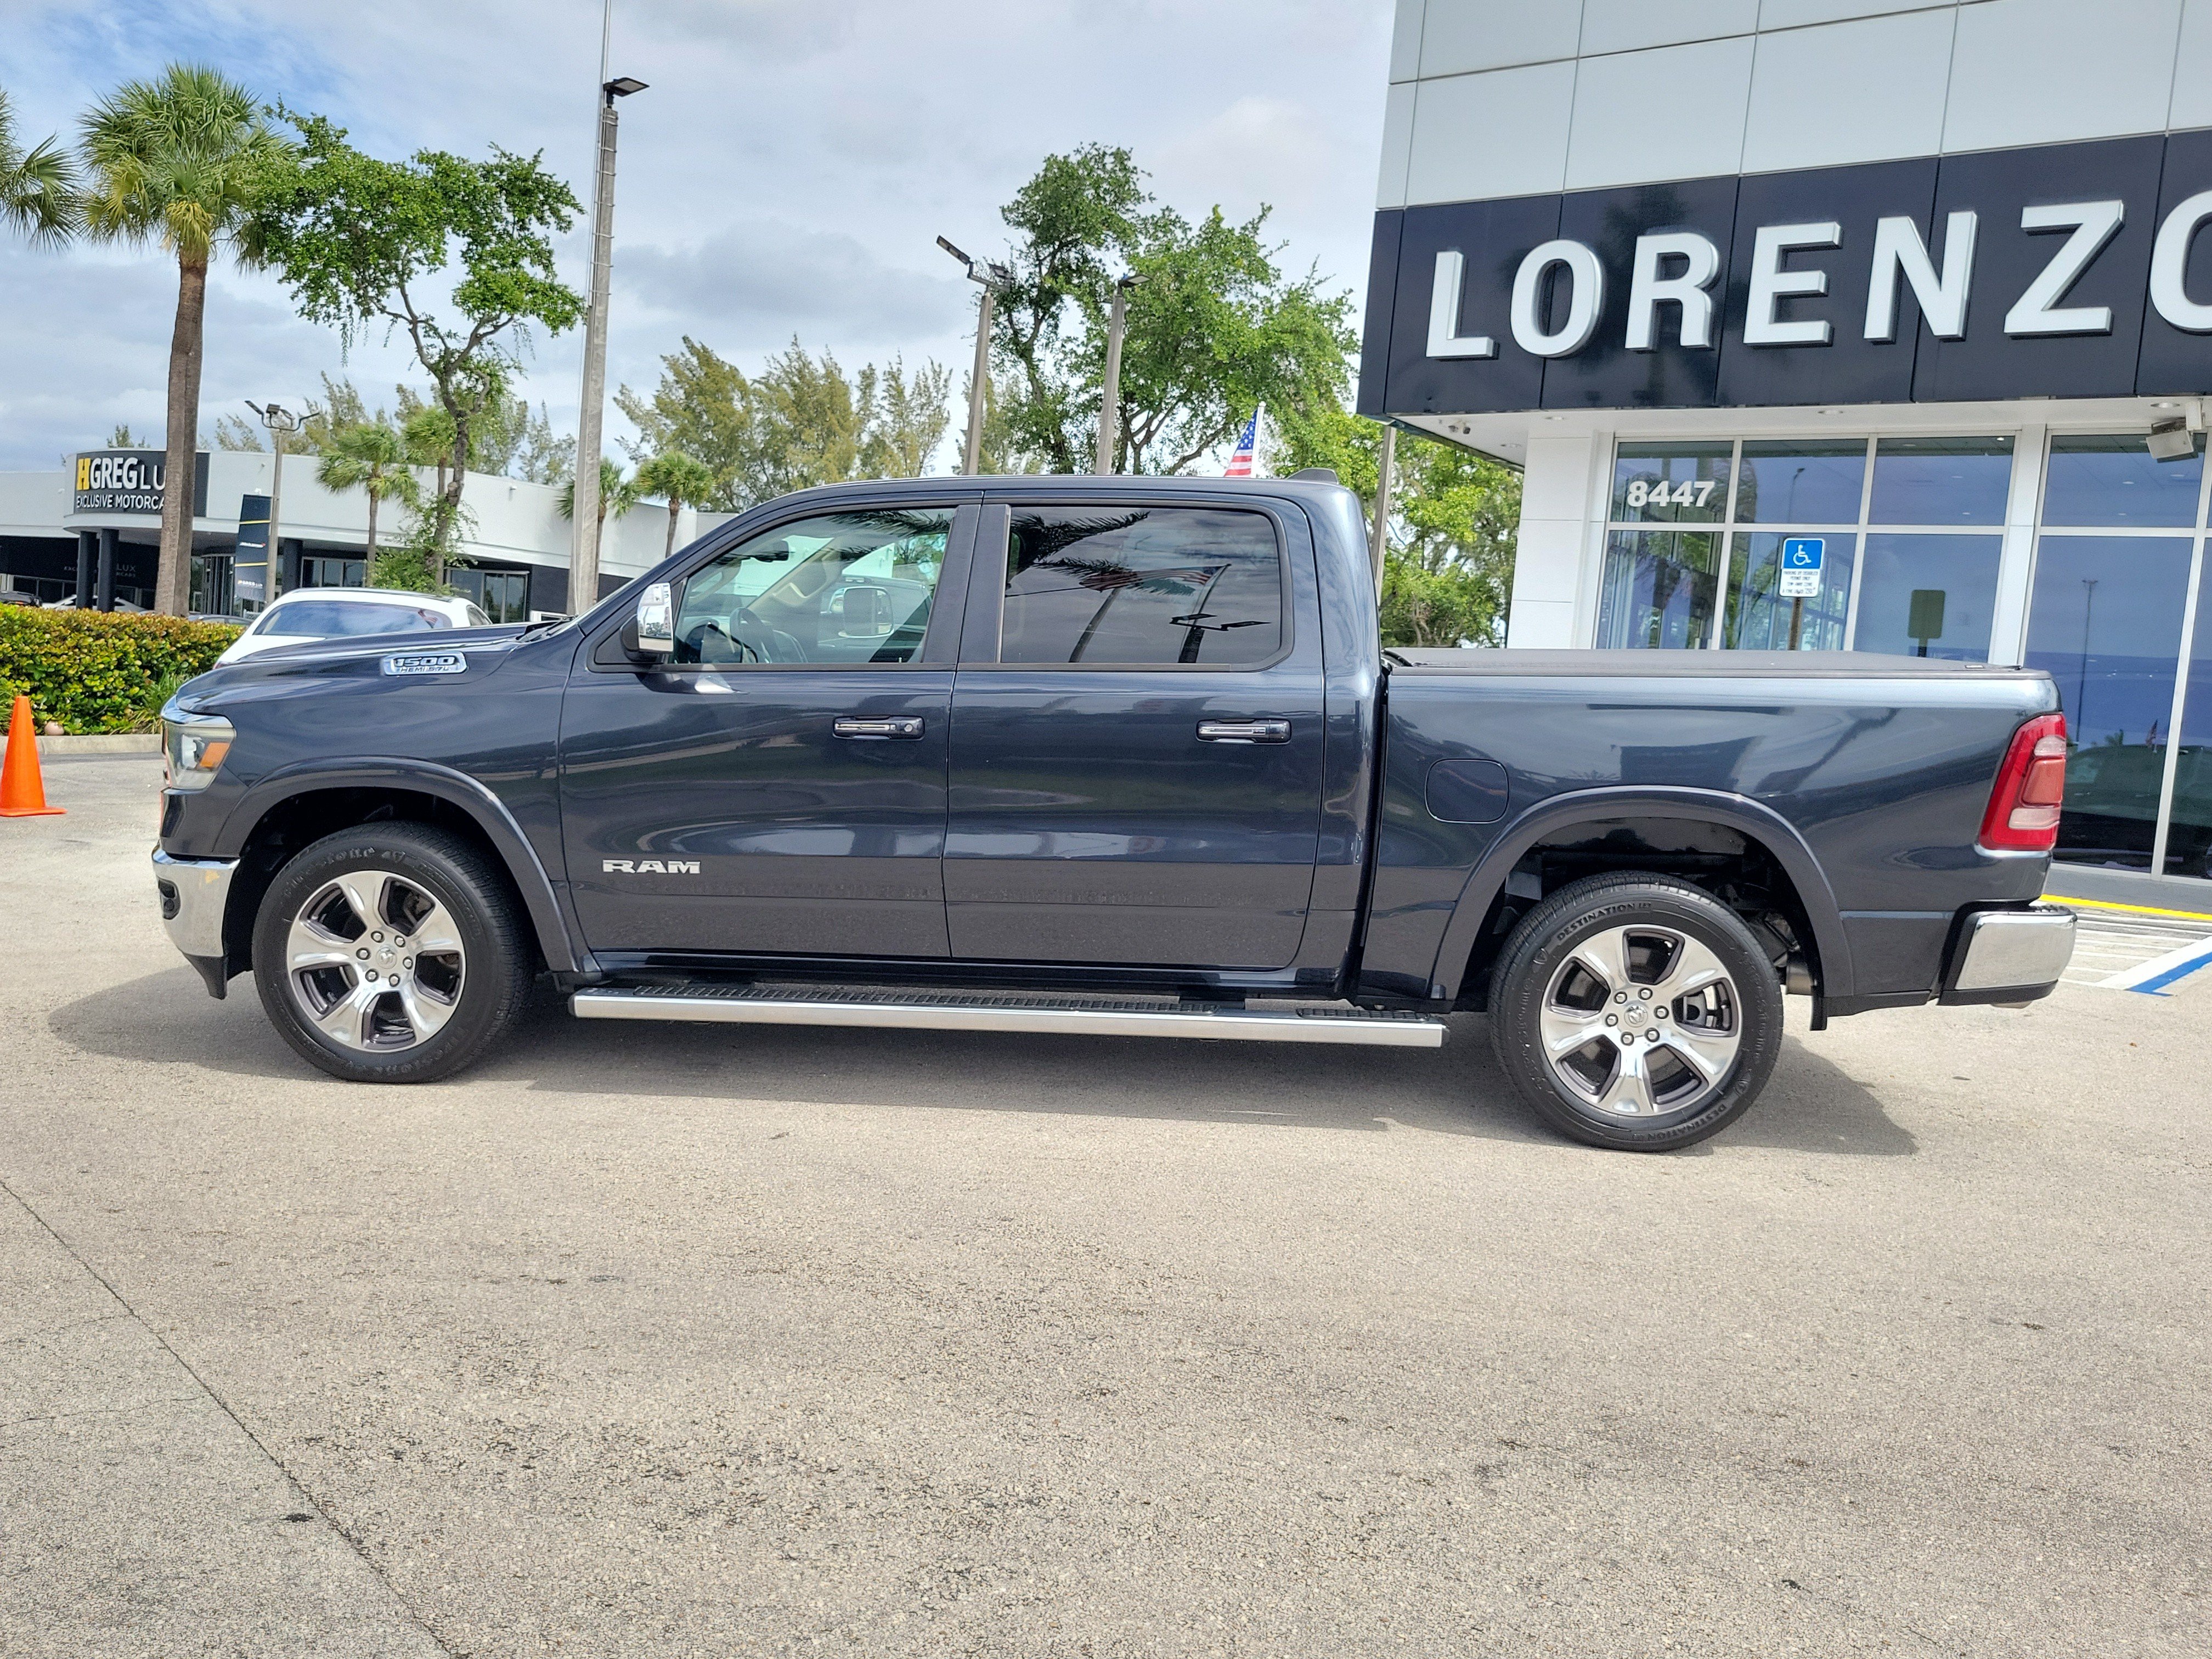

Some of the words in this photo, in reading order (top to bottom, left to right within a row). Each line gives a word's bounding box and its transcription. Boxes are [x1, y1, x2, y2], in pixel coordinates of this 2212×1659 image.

[1426, 190, 2212, 359] LORENZO
[76, 457, 166, 490] HGREGLU
[76, 494, 113, 509] EXCLUSIVE
[115, 494, 165, 510] MOTORCA
[1627, 480, 1716, 507] 8447
[393, 657, 455, 667] 1500
[602, 859, 701, 874] RAM
[1557, 902, 1636, 941] DESTINATION
